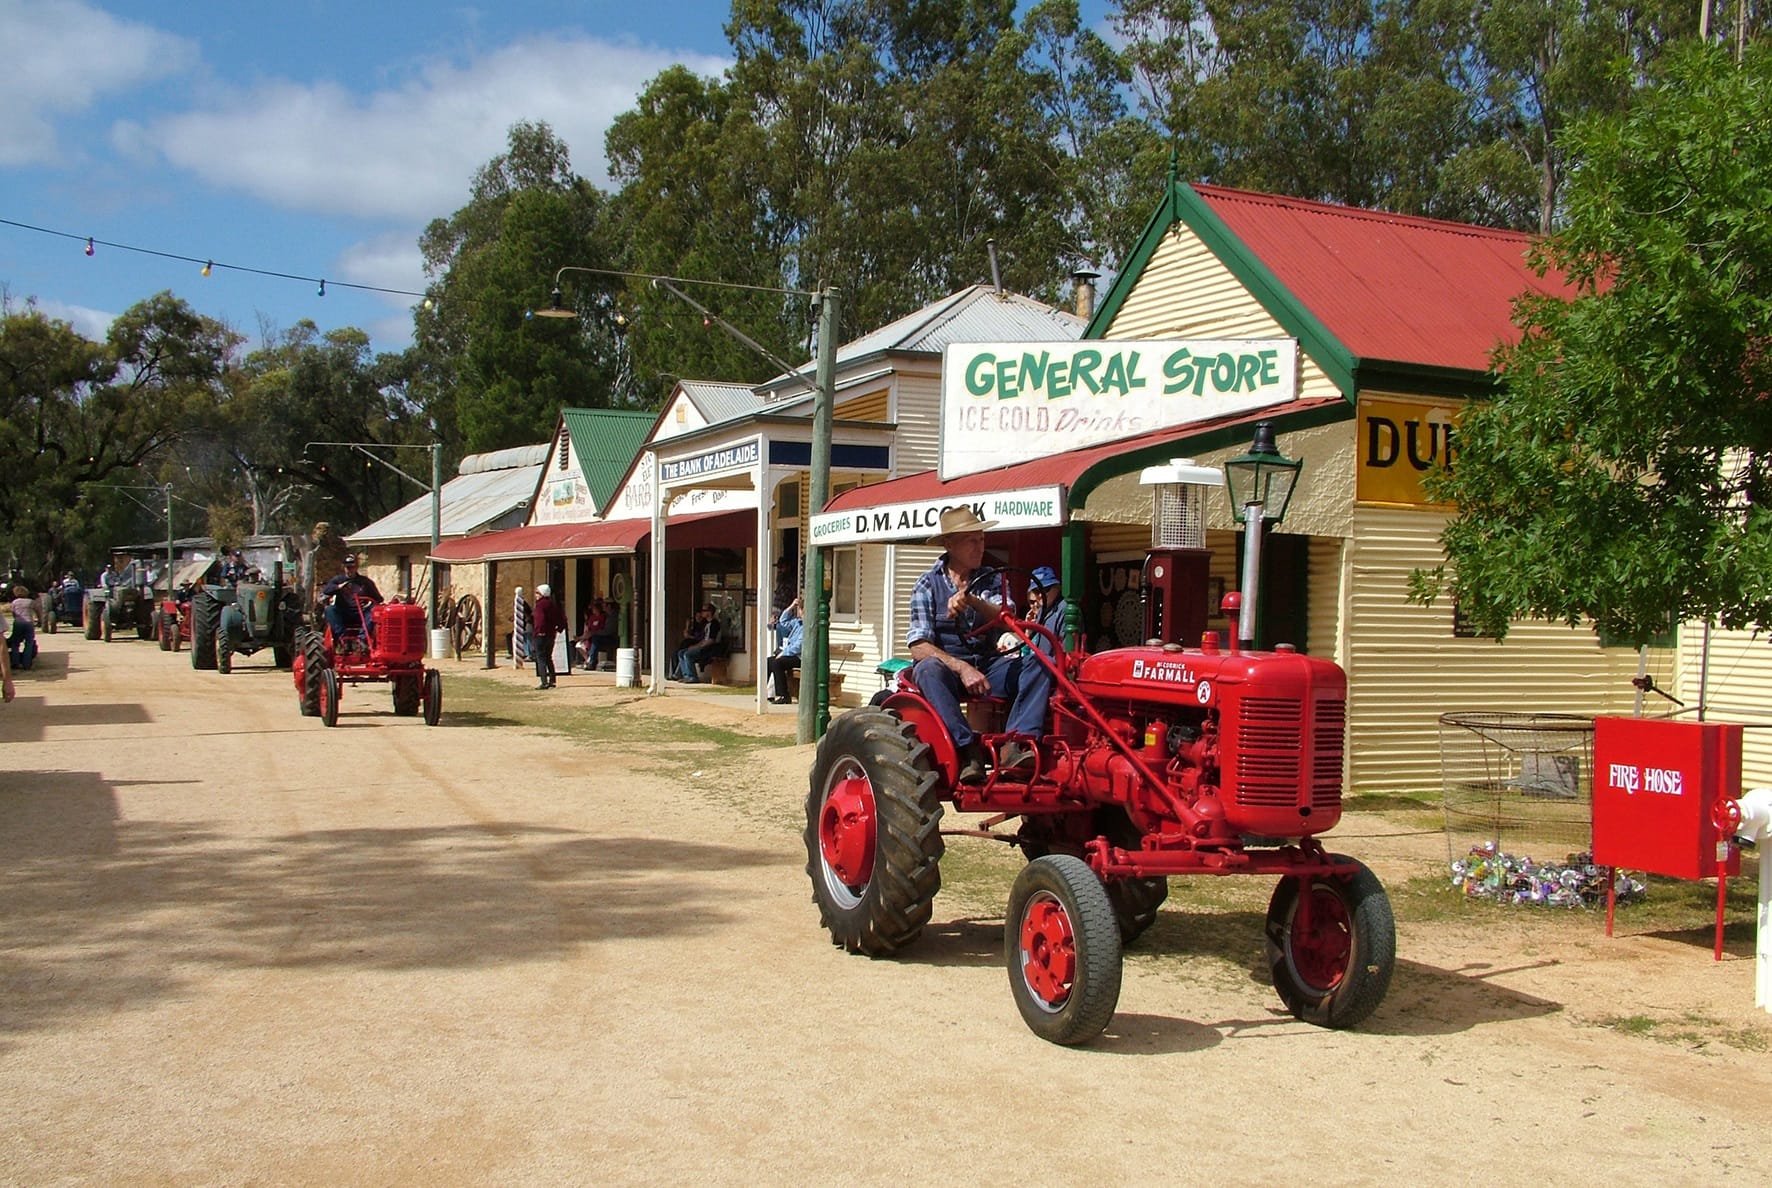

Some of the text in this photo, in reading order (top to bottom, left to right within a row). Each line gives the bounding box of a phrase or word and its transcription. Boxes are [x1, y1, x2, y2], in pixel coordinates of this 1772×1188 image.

[964, 347, 1281, 402] GENERAL STORE
[958, 406, 1142, 433] ICE COLD Drinks
[664, 464, 678, 479] THE
[679, 459, 702, 476] BANK
[703, 455, 713, 470] OF
[813, 517, 851, 537] GROCERIES
[897, 501, 986, 531] ALCK
[994, 500, 1054, 517] HARDWARE
[1145, 667, 1195, 682] FARMALL
[1200, 688, 1207, 699] A
[1609, 764, 1682, 795] FIRE HOSE
